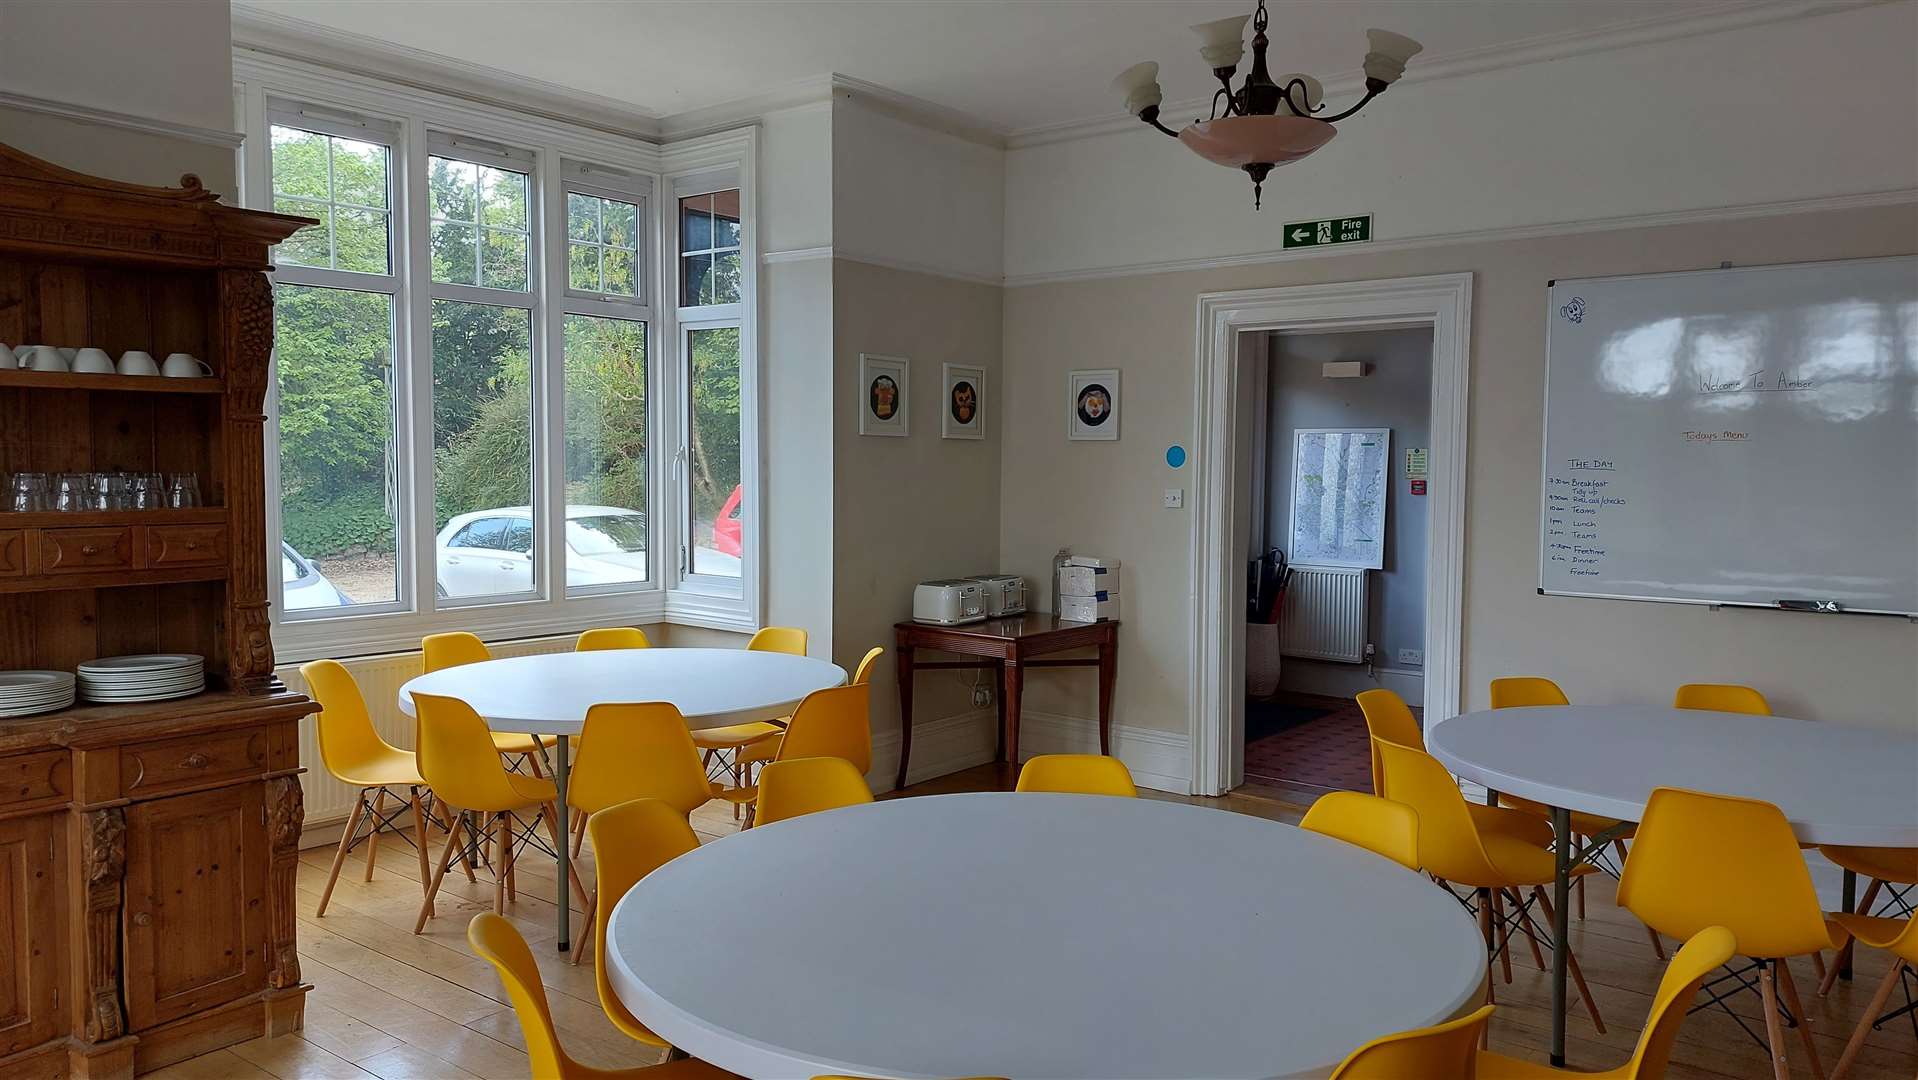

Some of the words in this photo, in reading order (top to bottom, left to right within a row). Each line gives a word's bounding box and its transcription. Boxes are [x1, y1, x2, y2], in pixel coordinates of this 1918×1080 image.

[1341, 220, 1362, 230] Fire
[1340, 230, 1361, 240] exit
[1700, 374, 1743, 392] Welcome
[1749, 370, 1765, 389] To
[1777, 368, 1814, 389] Amber
[1682, 431, 1718, 444] Todays
[1723, 430, 1749, 440] Menu
[1568, 459, 1589, 468] THE
[1594, 460, 1613, 468] DAY
[1571, 478, 1609, 488] Breakfast
[1571, 506, 1596, 515] Teams
[1571, 531, 1597, 539] Teams
